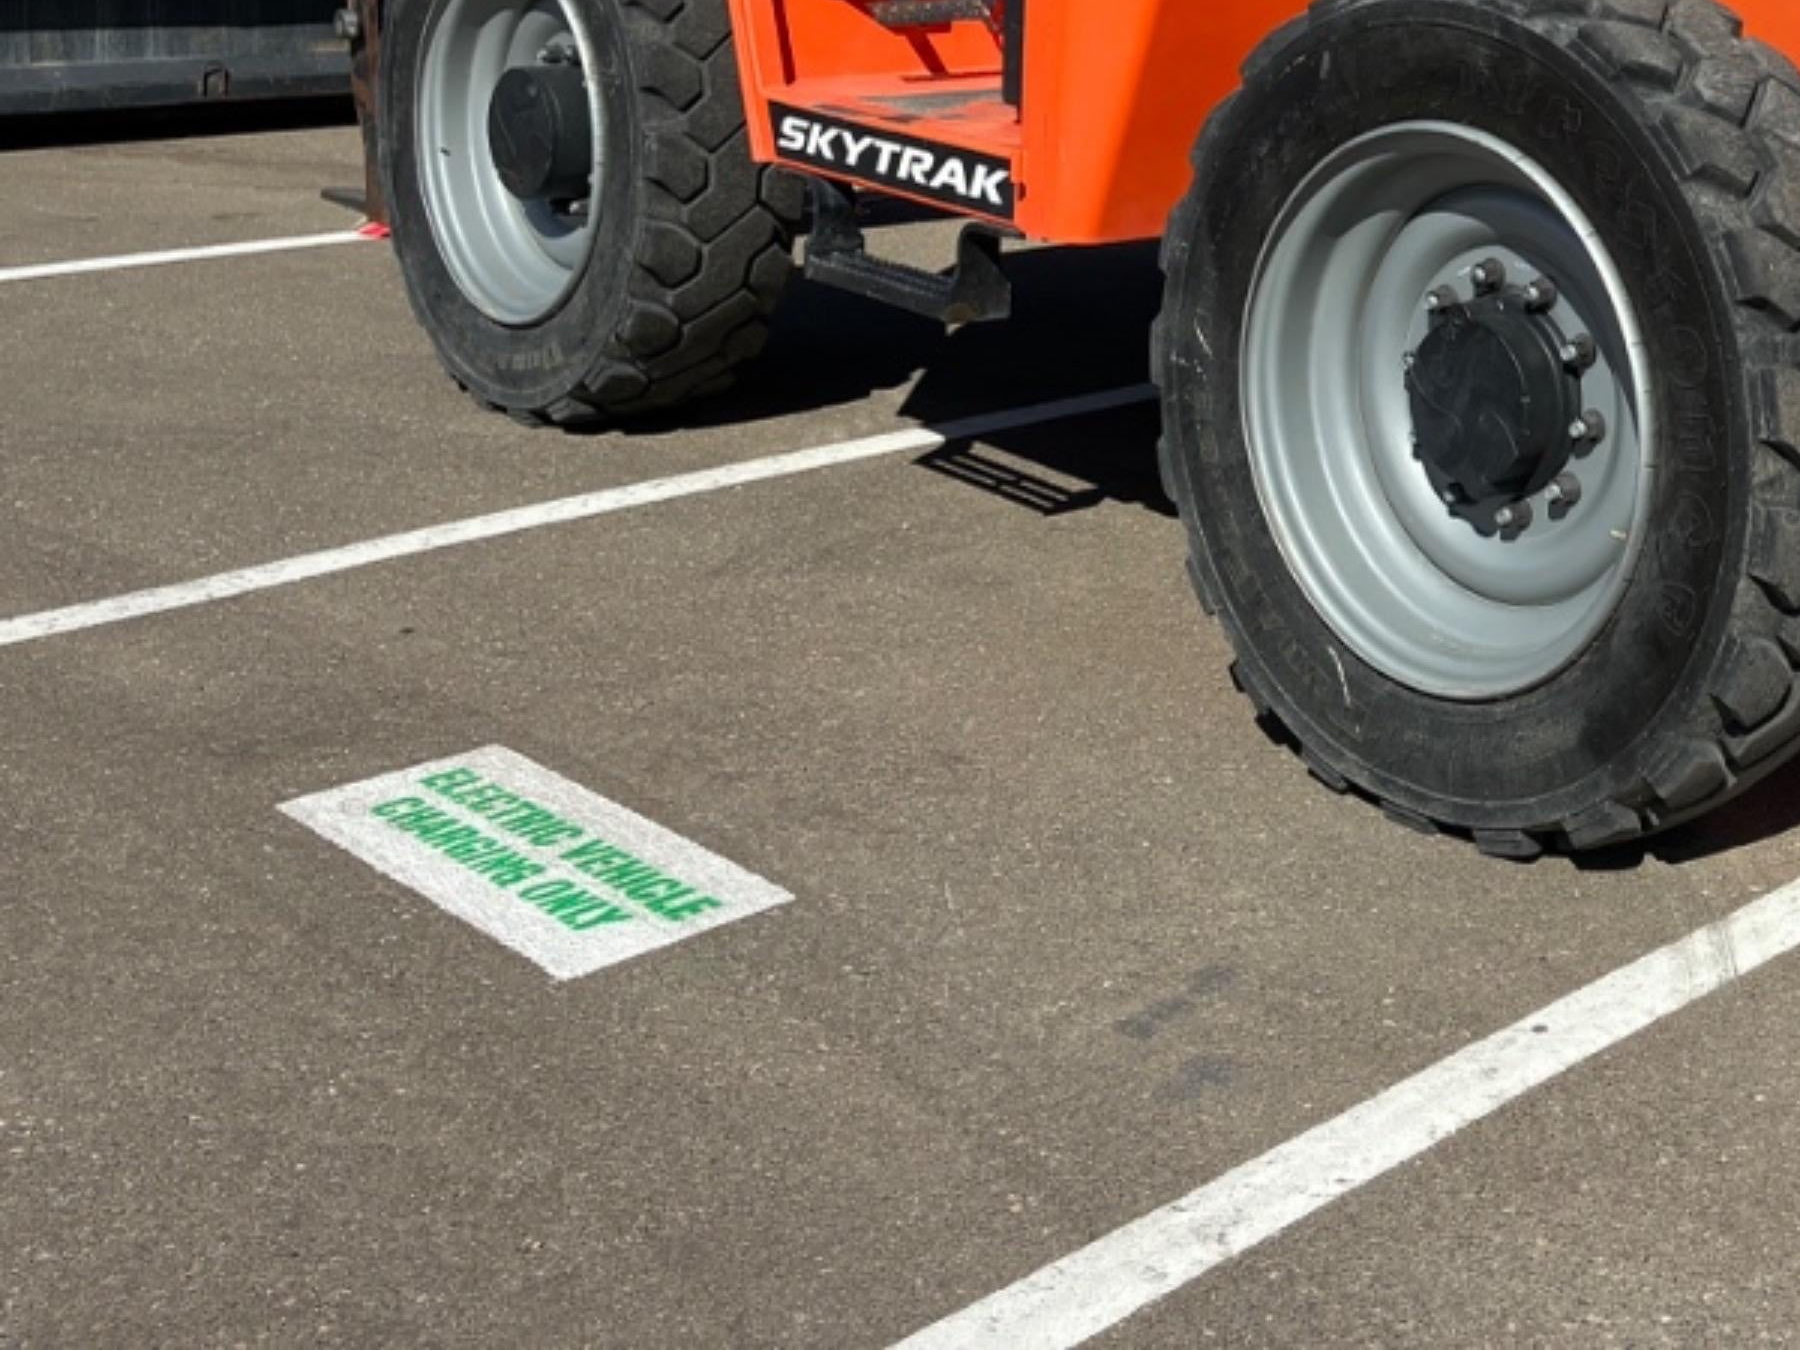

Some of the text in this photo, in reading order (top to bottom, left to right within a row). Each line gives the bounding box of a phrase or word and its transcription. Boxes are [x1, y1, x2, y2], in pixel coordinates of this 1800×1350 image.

[777, 114, 1009, 204] SKYTRAK
[371, 797, 633, 930] CHARGING ONLY
[419, 767, 722, 920] ELECTRIC VEHICLE
